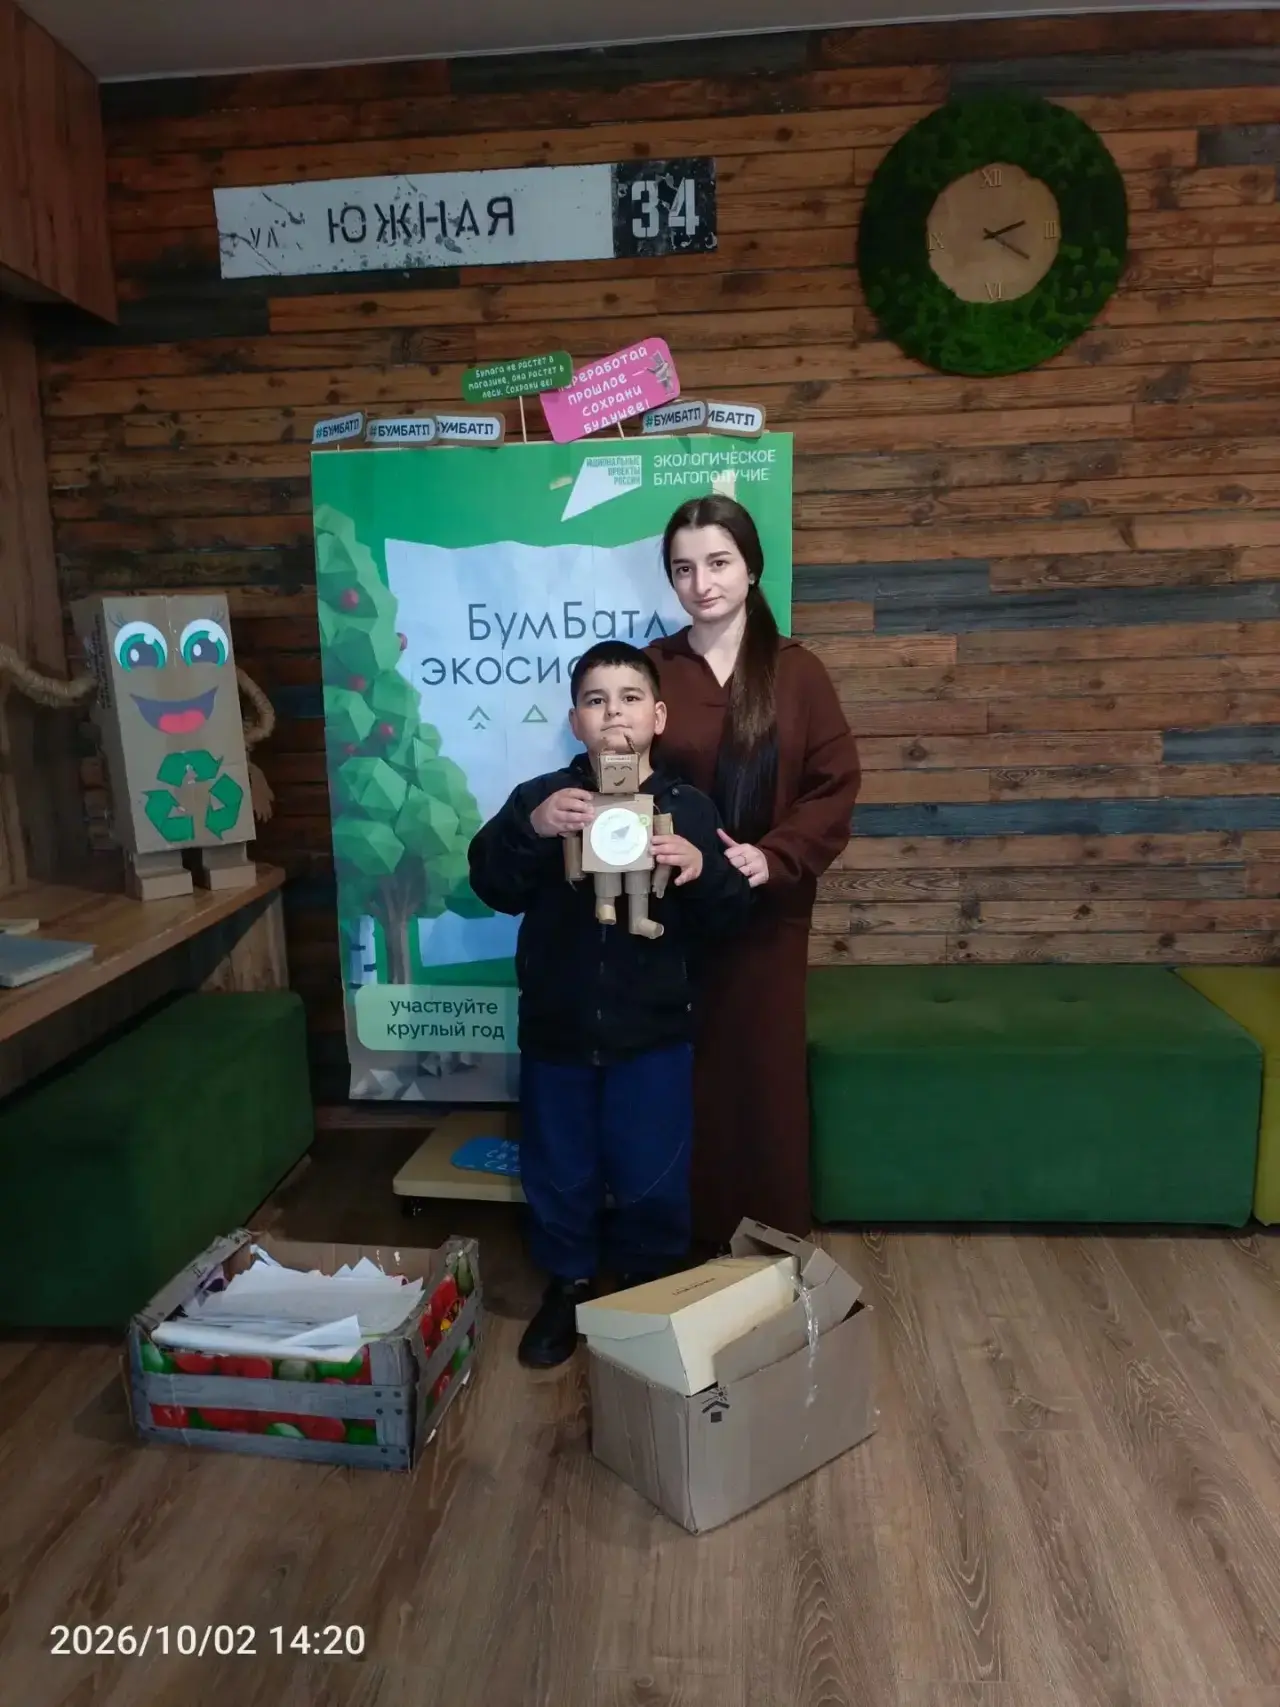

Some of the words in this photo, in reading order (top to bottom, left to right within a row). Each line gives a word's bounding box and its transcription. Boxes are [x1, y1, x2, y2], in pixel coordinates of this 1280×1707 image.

[978, 168, 1003, 189] XII
[328, 196, 515, 244] ЮЖНАЯ
[631, 177, 700, 238] 34
[653, 449, 776, 468] ЭКОЛОГИЧЕСКОЕ
[653, 467, 770, 486] БЛАГОПОЛУЧИЕ
[468, 601, 668, 650] БумБатл
[389, 998, 498, 1018] участвуйте
[386, 1021, 466, 1040] круглый
[472, 1025, 506, 1041] год
